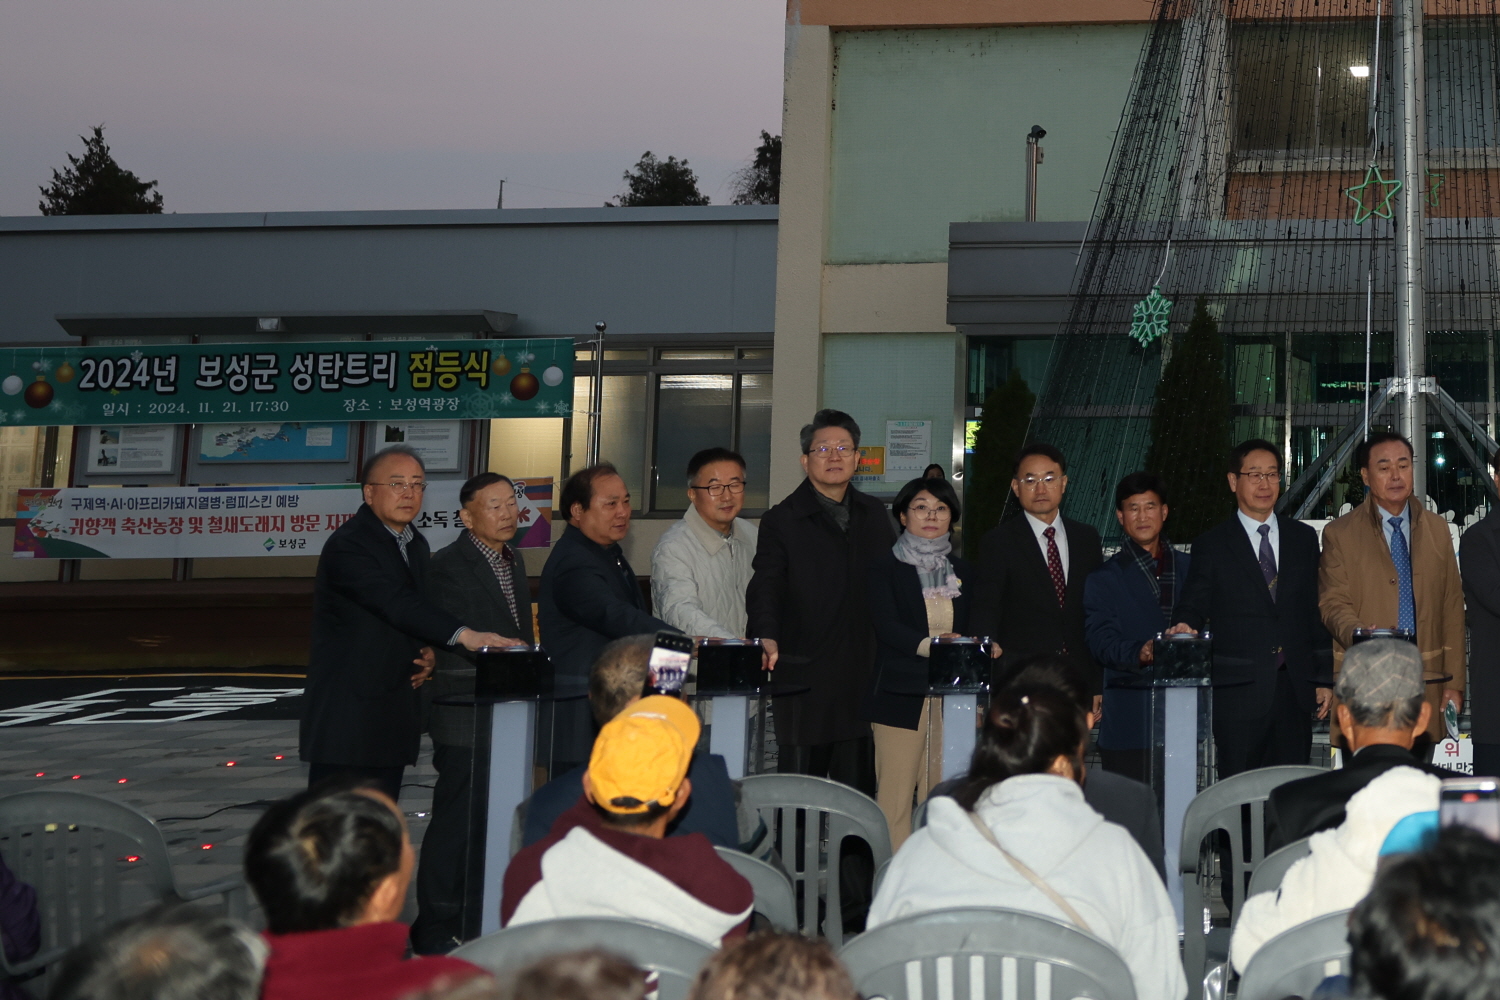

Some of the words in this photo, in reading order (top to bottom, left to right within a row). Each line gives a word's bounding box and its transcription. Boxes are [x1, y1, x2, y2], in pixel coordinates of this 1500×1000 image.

[79, 355, 177, 392] 2024년
[195, 354, 279, 392] 보성군
[289, 352, 397, 391] 성탄트리
[409, 350, 488, 389] 점등식
[102, 402, 130, 417] 일시
[148, 403, 190, 414] 2024.
[198, 402, 214, 414] 11.
[222, 402, 242, 413] 21.
[249, 400, 290, 413] 17:30
[342, 399, 371, 413] 장소
[389, 397, 461, 412] 보성역광장
[275, 494, 300, 509] 예방
[69, 517, 117, 536] 귀향객
[121, 516, 184, 536] 축산농장
[188, 516, 204, 535] 및
[208, 514, 285, 534] 철새도래지
[290, 514, 320, 533] 방문
[417, 510, 448, 529] 소독
[278, 538, 307, 550] 보성군
[1445, 743, 1459, 756] 위
